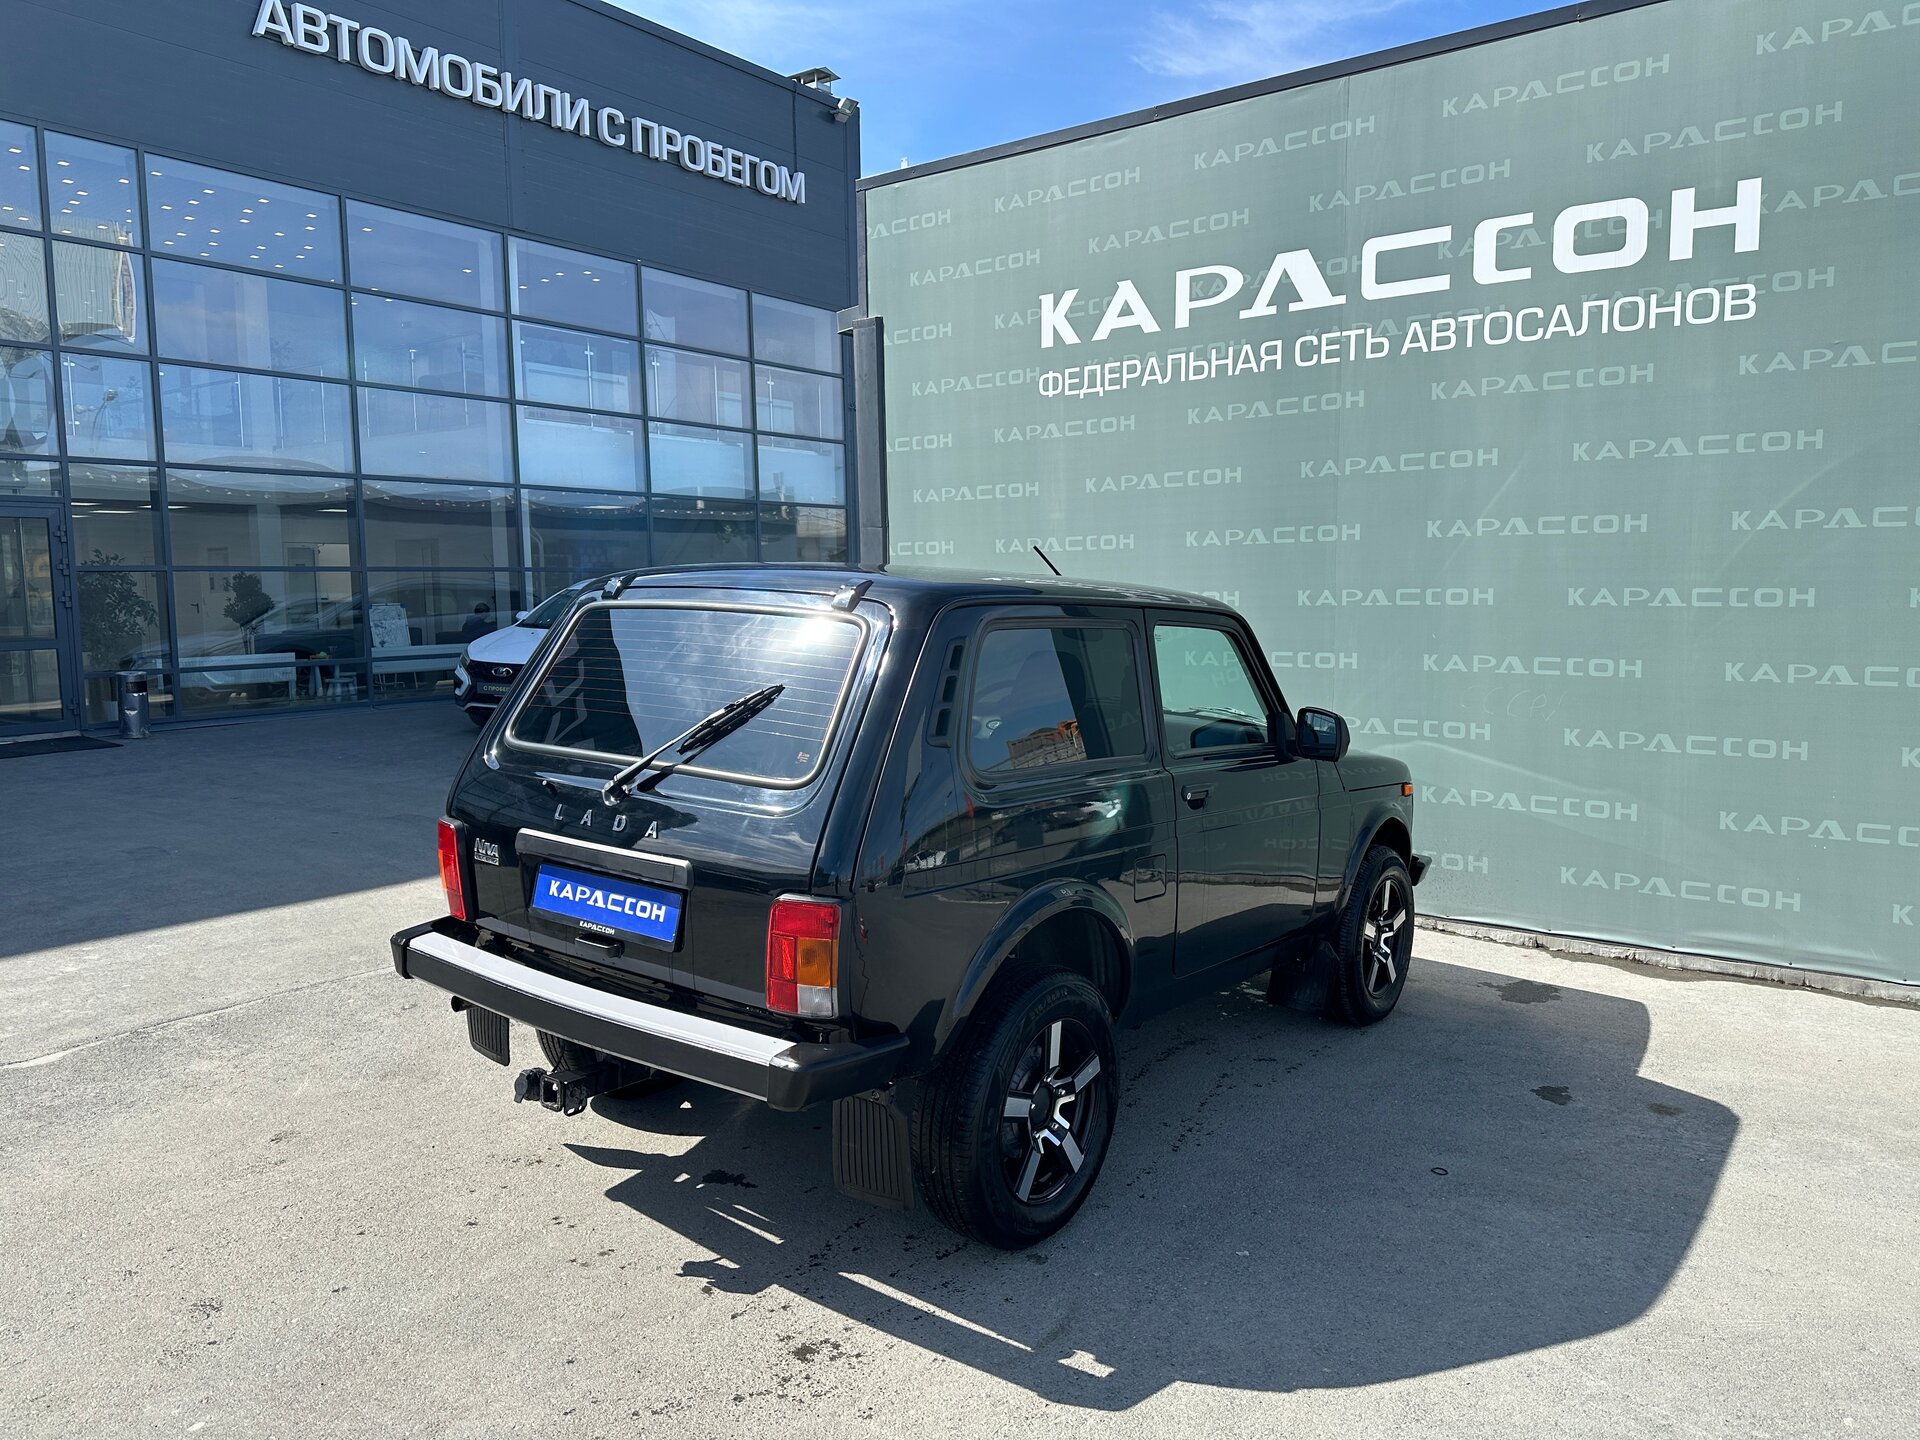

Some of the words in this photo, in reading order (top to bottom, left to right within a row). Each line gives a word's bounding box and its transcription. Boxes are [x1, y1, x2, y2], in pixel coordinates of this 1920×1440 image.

[252, 0, 591, 137] АВТОМОБИЛИ
[597, 107, 625, 147] С
[631, 116, 806, 204] ПРОБЕГОМ
[1039, 177, 1762, 348] КАРАССОН
[1039, 340, 1283, 399] ФЕДЕРАЛЬНАЯ
[1294, 328, 1390, 367] СЕТЬ
[1400, 283, 1757, 356] АВТОСАЛОНОВ
[1731, 506, 1920, 531] КАРАС
[554, 803, 658, 838] LADA
[549, 880, 666, 923] КАРАССОН
